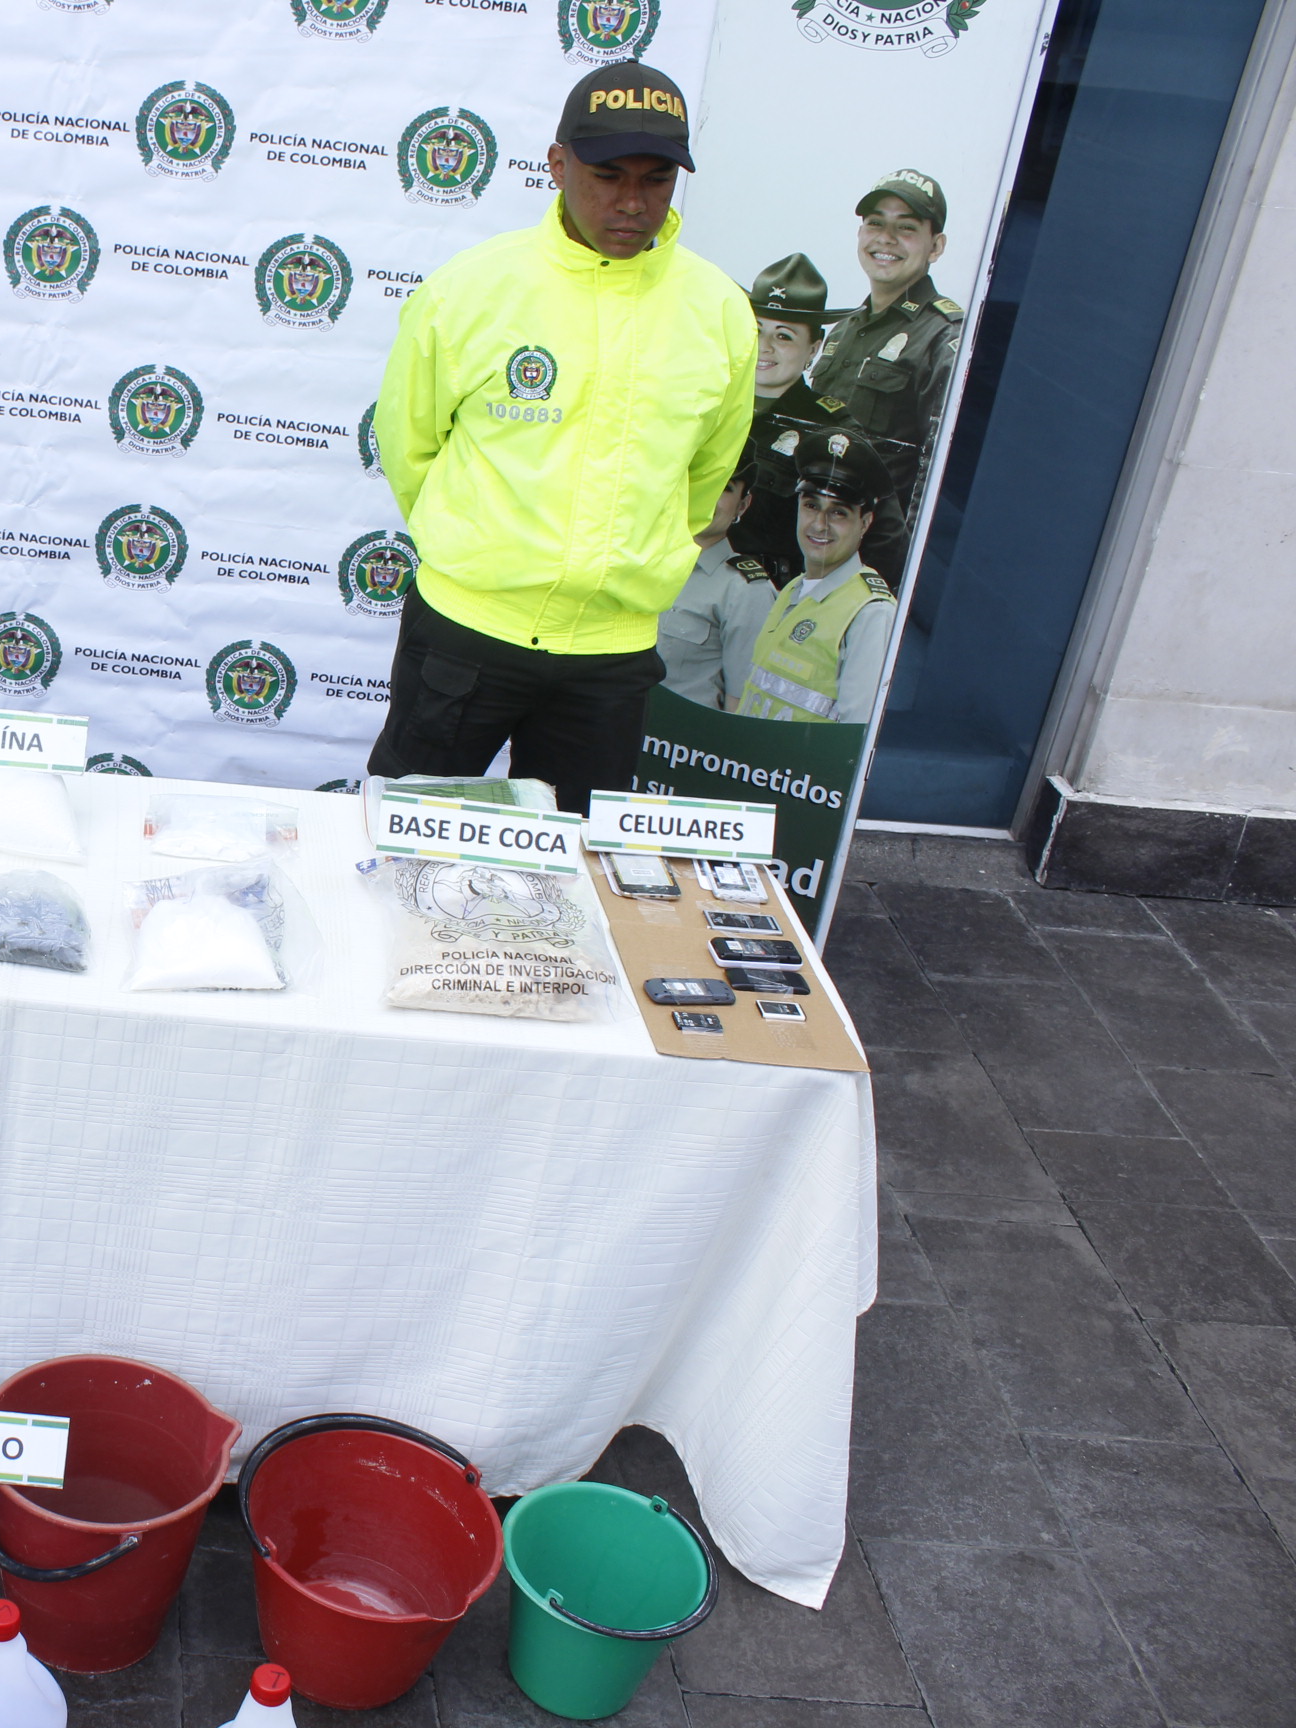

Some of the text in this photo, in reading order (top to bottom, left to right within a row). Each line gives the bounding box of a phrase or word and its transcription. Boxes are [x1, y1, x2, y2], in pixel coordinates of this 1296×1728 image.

[822, 13, 934, 46] DIOS Y PATRIA
[589, 88, 685, 122] POLICIA
[54, 116, 130, 132] NACIONAL
[203, 98, 223, 139] COLOMBIA
[11, 128, 109, 146] DE COLOMBIA
[250, 133, 388, 156] POLICÍA NACIONAL
[465, 125, 486, 166] COLOMBIA
[182, 148, 218, 168] NACIONAL
[267, 151, 366, 170] DE COLOMBIA
[508, 159, 550, 173] POLIC
[181, 168, 207, 177] PATRIA
[443, 174, 478, 195] NACIONAL
[525, 177, 544, 188] DE
[441, 195, 467, 204] PATRIA
[114, 244, 249, 266] POLICÍA NACIONAL
[131, 261, 228, 279] DE COLOMBIA
[321, 251, 341, 291] COLOMBIA
[367, 269, 423, 284] POLICÍA
[384, 287, 402, 298] DE
[300, 299, 335, 318] NACIONAL
[298, 318, 324, 327] PATRIA
[29, 394, 101, 409] NACIONAL
[9, 407, 81, 423] COLOMBIA
[486, 402, 562, 423] 100883
[217, 413, 349, 436] POLICÍA NACIONAL
[234, 430, 328, 449] DE COLOMBIA
[19, 533, 90, 548] NACIONAL
[158, 520, 176, 556] COLOMBIA
[0, 546, 70, 560] COLOMBIA
[201, 551, 330, 573] POLICÍA NACIONAL
[138, 563, 172, 581] NACIONAL
[217, 567, 309, 585] DE COLOMBIA
[137, 581, 161, 589] PATRIA
[75, 647, 201, 668] POLICÍA NACIONAL
[91, 662, 181, 680] DE COLOMBIA
[310, 673, 363, 686] POLICÍA
[326, 688, 343, 697] DE
[642, 735, 843, 809] mprometidos
[388, 814, 567, 854] BASE DE COCA
[618, 813, 745, 841] CELULARES
[418, 862, 440, 893] REPUB
[442, 949, 577, 965] POLICÍA NACIONAL
[400, 961, 481, 976] DIRECCIÓN
[486, 964, 504, 976] DE
[431, 978, 589, 996] CRIMINAL E INTERPOL
